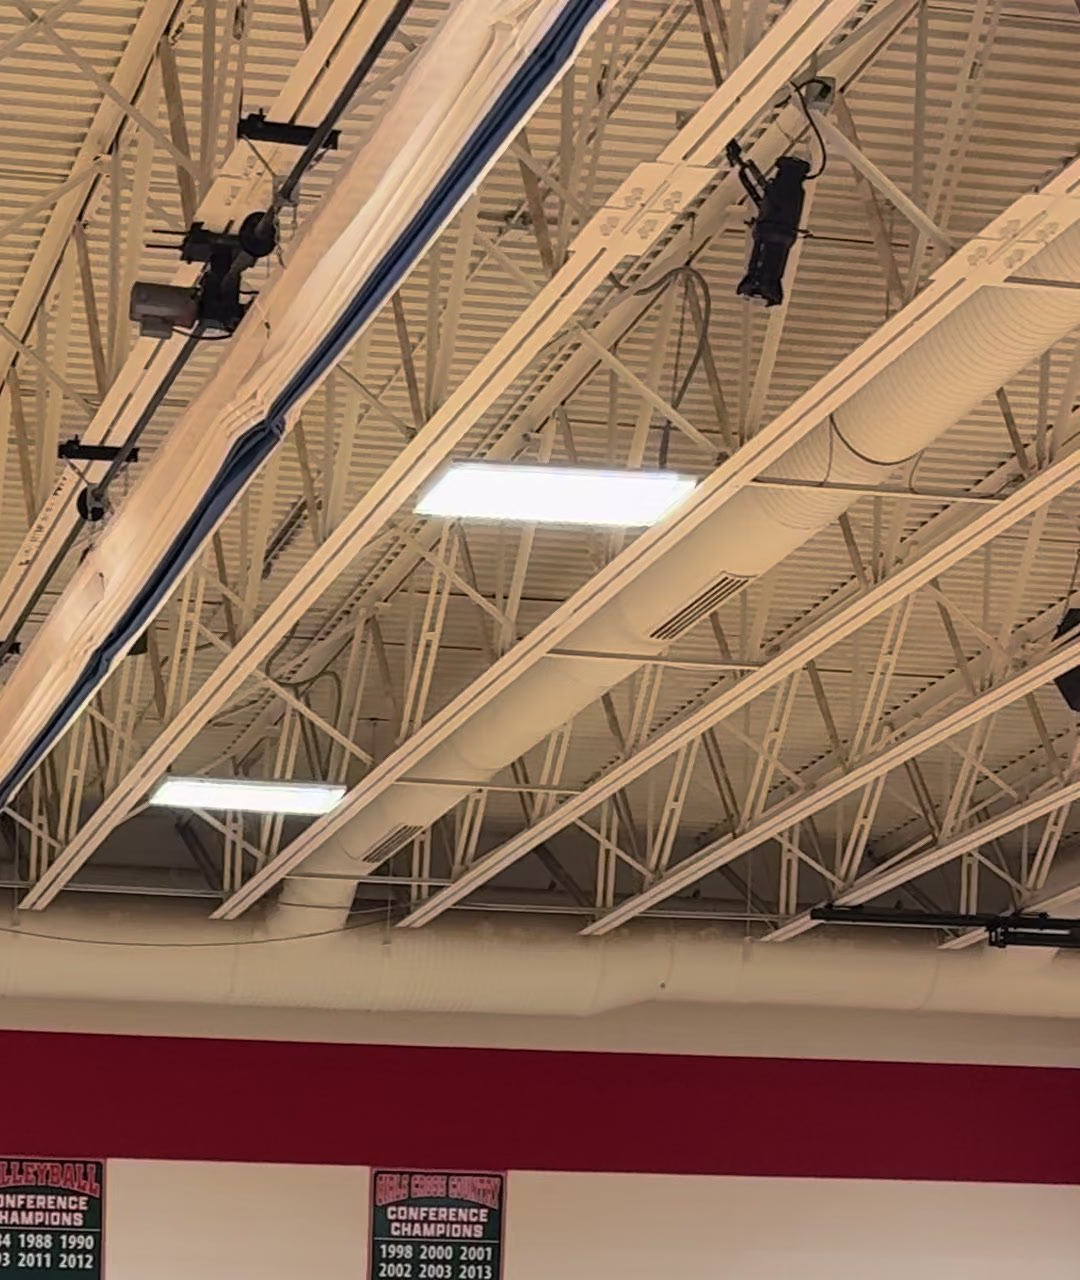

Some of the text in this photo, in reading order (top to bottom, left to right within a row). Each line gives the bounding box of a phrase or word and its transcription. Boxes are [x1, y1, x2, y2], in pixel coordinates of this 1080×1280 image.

[386, 1206, 489, 1223] CONFERENCE
[390, 1222, 484, 1238] CHAMPIONS
[18, 1233, 53, 1249] 1988
[59, 1234, 95, 1250] 1990
[17, 1252, 52, 1268] 2011
[58, 1253, 94, 1269] 2012
[380, 1244, 493, 1261] 1998 2000 2001
[378, 1263, 493, 1280] 2002 2003 2013
